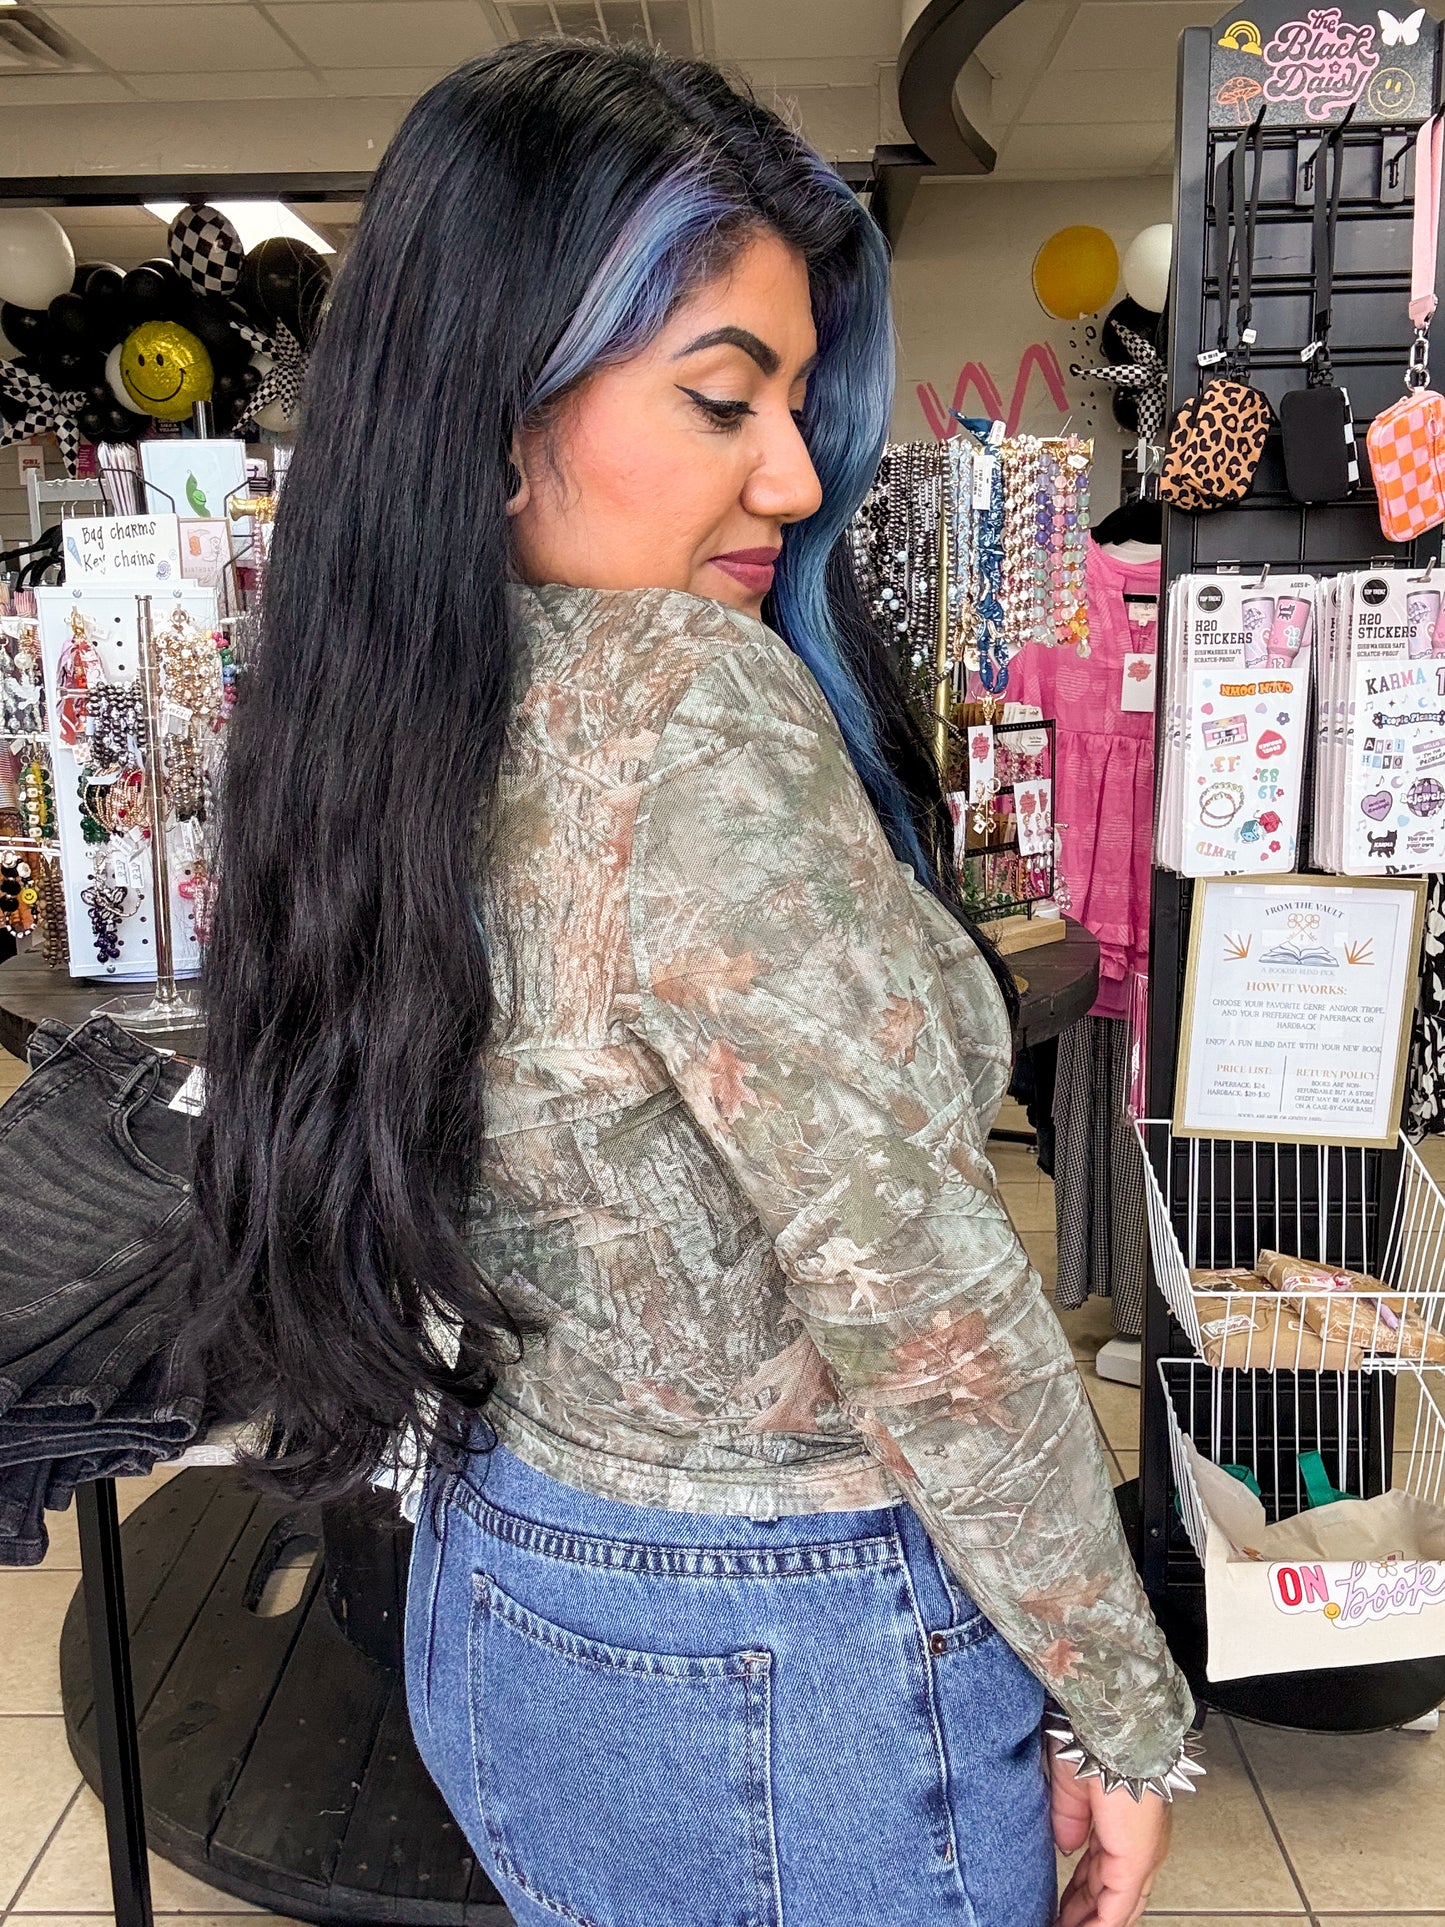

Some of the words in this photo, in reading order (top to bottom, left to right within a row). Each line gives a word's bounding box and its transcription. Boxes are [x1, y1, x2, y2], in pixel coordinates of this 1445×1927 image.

[1312, 10, 1340, 33] the
[1267, 23, 1377, 66] Black
[1267, 62, 1368, 118] Daisy
[82, 526, 104, 550] Bag
[83, 553, 106, 575] Key
[114, 550, 155, 568] chains
[1194, 632, 1253, 645] STICKERS
[1357, 626, 1418, 639] STICKERS
[1258, 681, 1293, 694] CALM
[1365, 667, 1426, 696] KARMA
[1219, 683, 1256, 697] DOWN
[1213, 756, 1236, 772] 13
[1265, 902, 1292, 916] FROM
[1294, 901, 1313, 910] THE
[1316, 902, 1345, 919] VAULT
[1246, 981, 1280, 992] HOW
[1282, 983, 1295, 993] IT
[1297, 983, 1347, 995] WORKS:
[1212, 998, 1241, 1007] CHOOSE
[1244, 1000, 1263, 1008] YOUR
[1266, 1001, 1300, 1010] FAVORITE
[1303, 1003, 1326, 1011] GENRE
[1329, 1004, 1358, 1013] AND/OR
[1221, 1009, 1238, 1017] AND
[1240, 1010, 1259, 1018] YOUR
[1262, 1011, 1305, 1020] PREFERENCE
[1320, 1014, 1361, 1023] PAPERBACK
[1276, 1021, 1316, 1030] HARDBACK
[1205, 1038, 1227, 1046] ENJOY
[1254, 1040, 1275, 1048] BLIND
[1277, 1041, 1296, 1049] DATE
[1299, 1042, 1318, 1050] WITH
[1321, 1043, 1340, 1051] YOUR
[1343, 1044, 1360, 1052] NEW
[1216, 1064, 1247, 1073] PRICE
[1296, 1068, 1338, 1078] RETURN
[1296, 1087, 1333, 1095] REFUNDABLE
[1312, 1104, 1354, 1112] CASE-BY-CASE
[1341, 1097, 1375, 1105] AVAILABLE
[1277, 1564, 1330, 1606] ON
